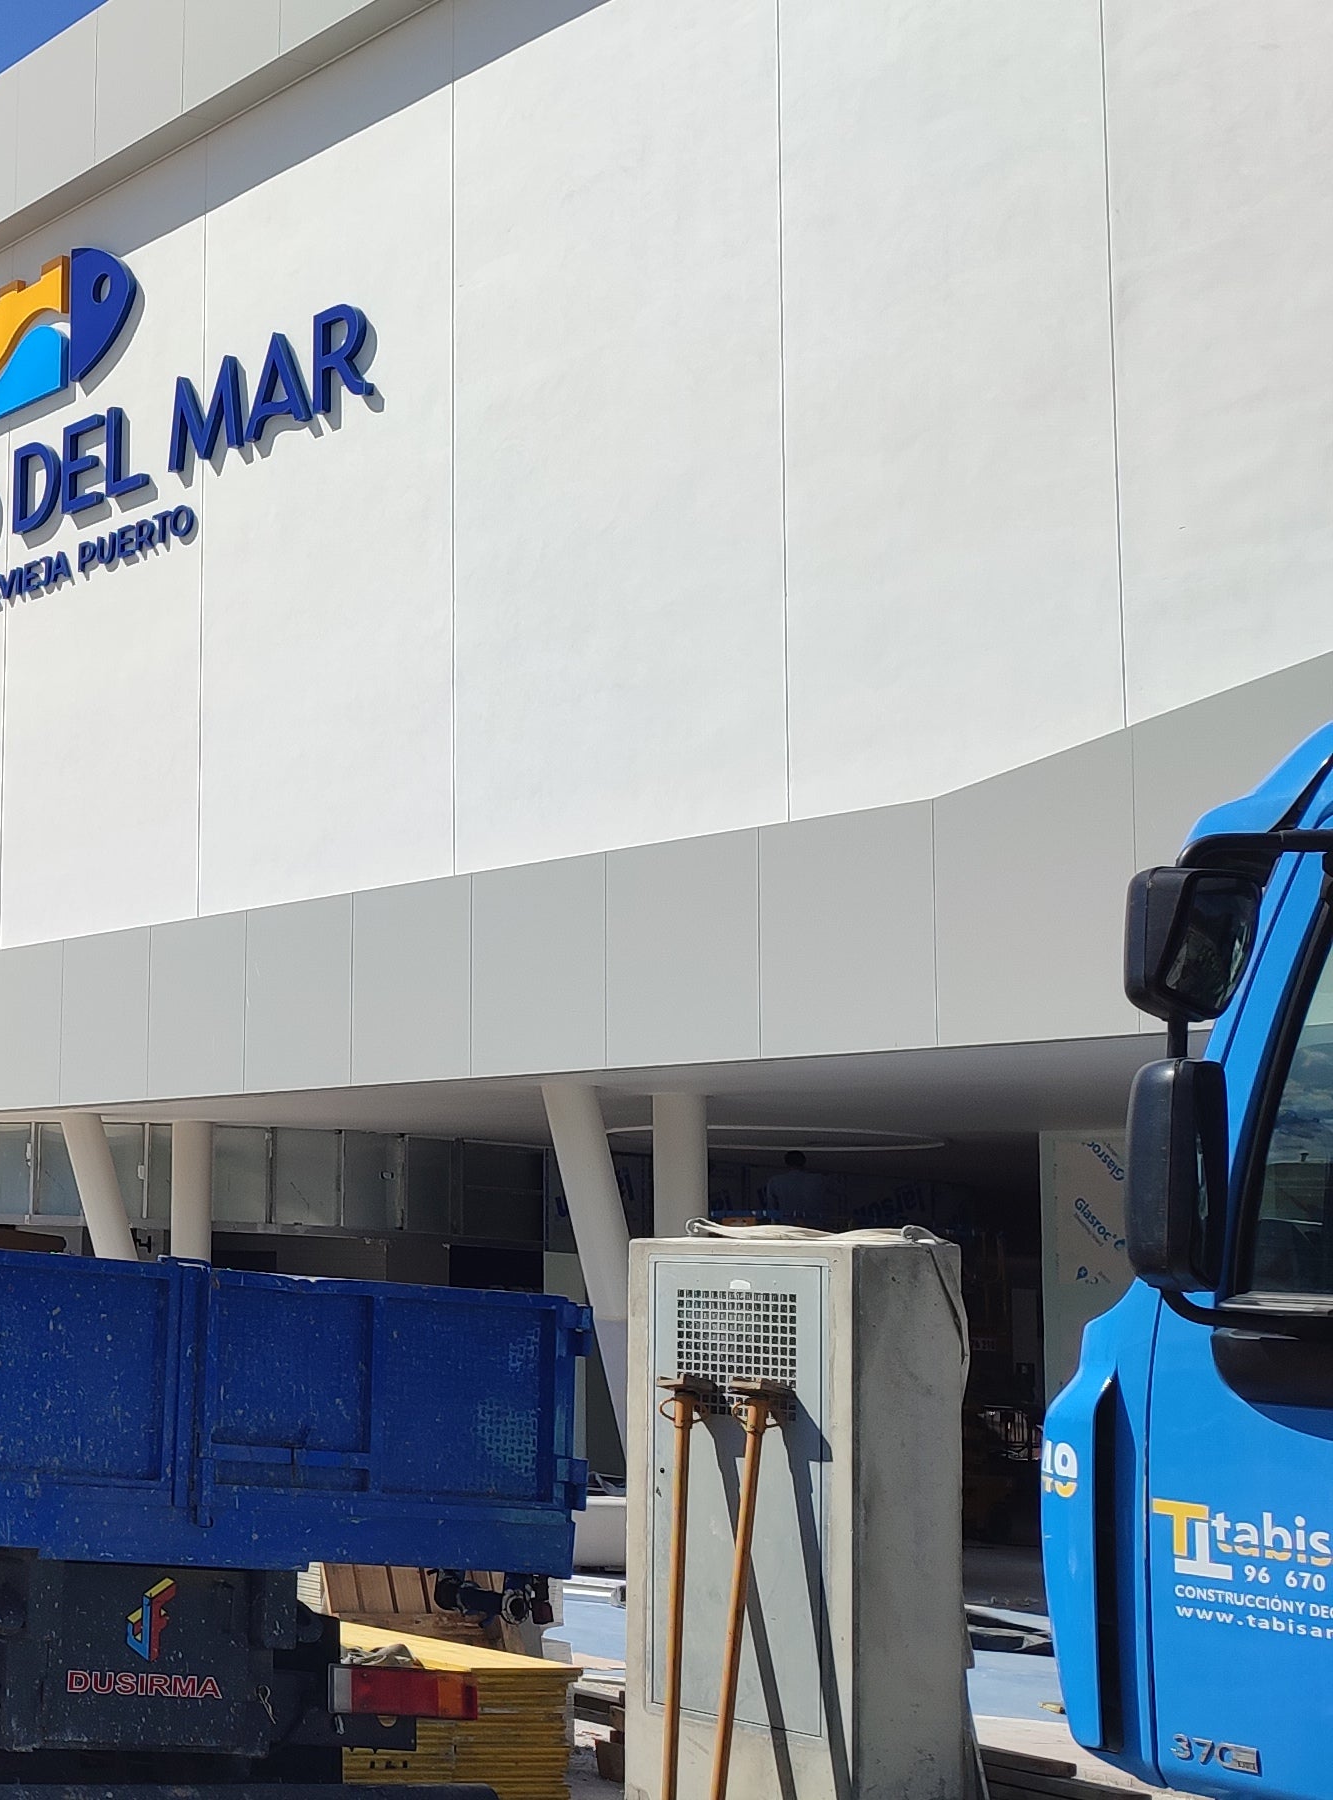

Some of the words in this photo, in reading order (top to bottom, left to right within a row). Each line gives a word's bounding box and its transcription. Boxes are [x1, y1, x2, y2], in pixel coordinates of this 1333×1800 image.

[12, 406, 150, 535] DEL
[167, 303, 374, 473] MAR
[77, 503, 195, 573] PUERTO
[1074, 1197, 1112, 1242] Glasroc
[1243, 1564, 1272, 1584] 96
[1285, 1570, 1327, 1592] 670
[66, 1669, 223, 1700] DUSIRMA
